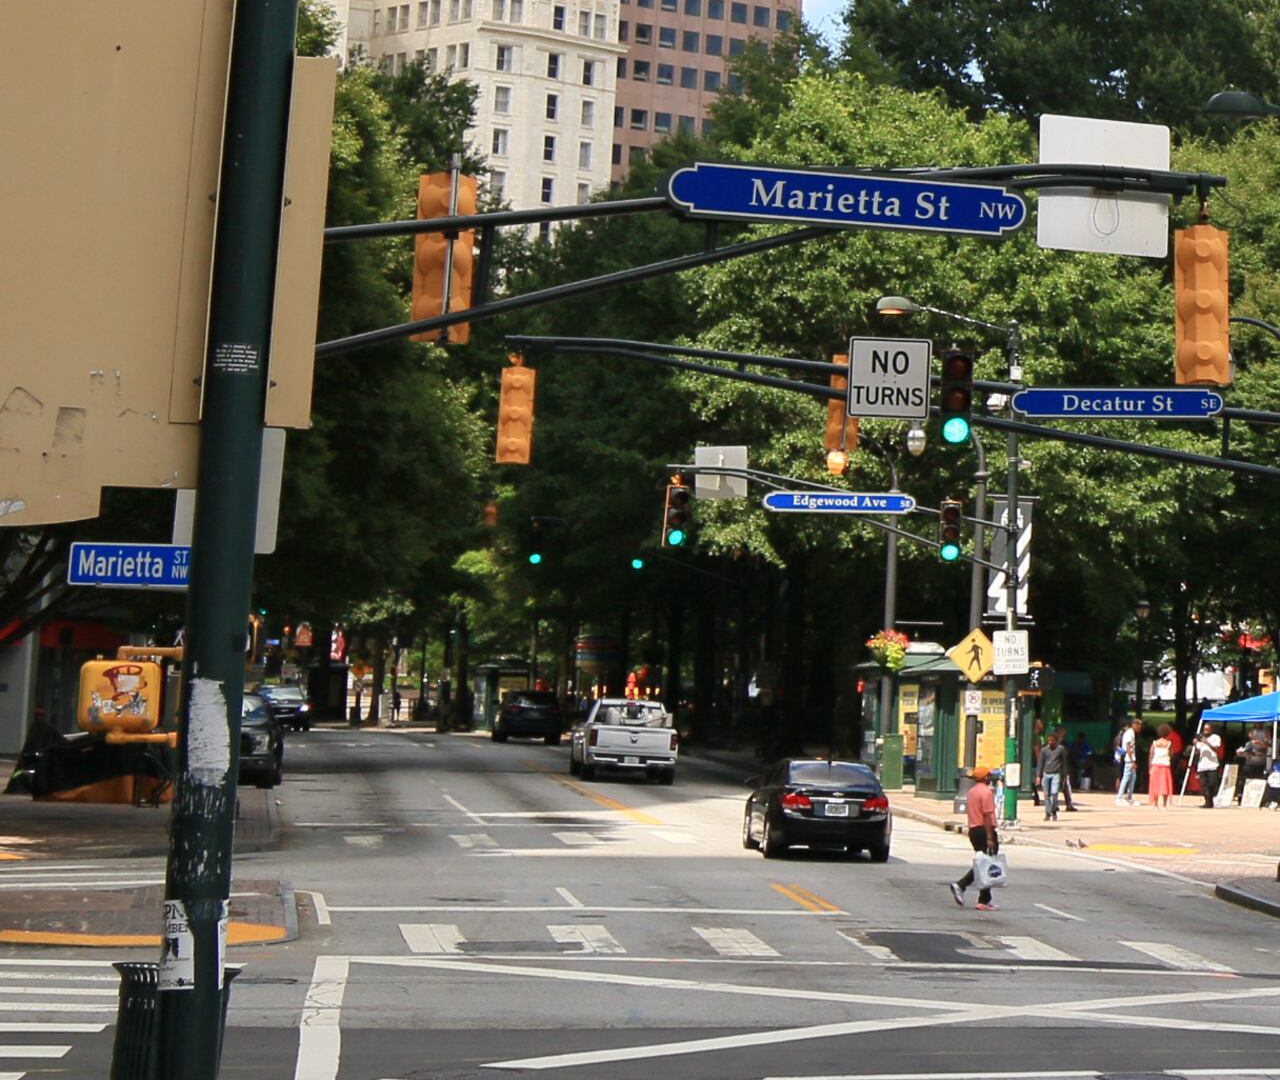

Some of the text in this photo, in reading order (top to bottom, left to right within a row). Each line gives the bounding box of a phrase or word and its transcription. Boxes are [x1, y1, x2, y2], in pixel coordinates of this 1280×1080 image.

[748, 177, 1017, 221] Marietta St NW
[870, 350, 910, 375] NO
[852, 385, 925, 408] TURNS
[1062, 394, 1218, 413] Decatur St SE
[792, 495, 912, 510] Edgewood Ave SE
[78, 549, 189, 578] Marietta ST
[171, 565, 189, 579] NW
[1004, 634, 1017, 644] NO
[996, 647, 1026, 658] TURNS
